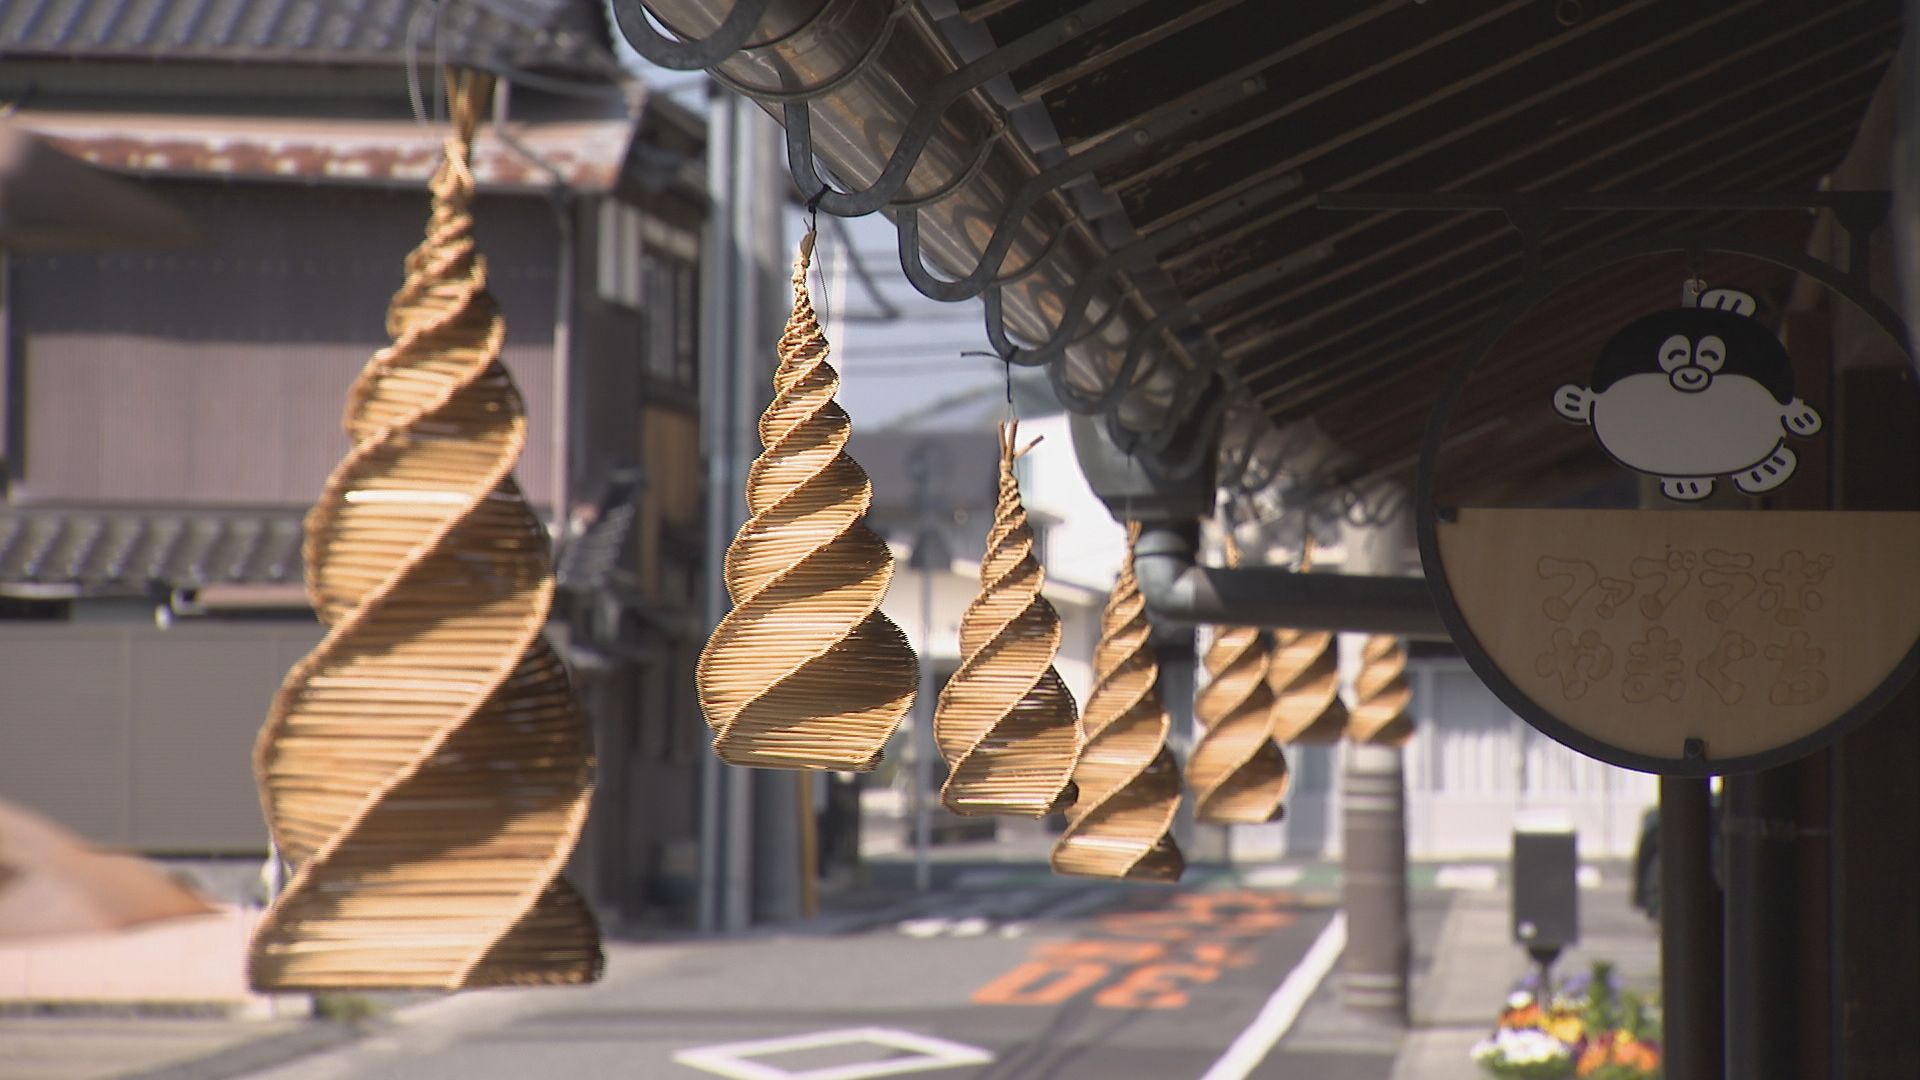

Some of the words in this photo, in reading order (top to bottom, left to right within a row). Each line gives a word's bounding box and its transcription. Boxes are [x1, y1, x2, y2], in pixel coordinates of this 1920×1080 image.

[1537, 550, 1834, 626] ファブラボ
[1535, 626, 1830, 706] やまぐち
